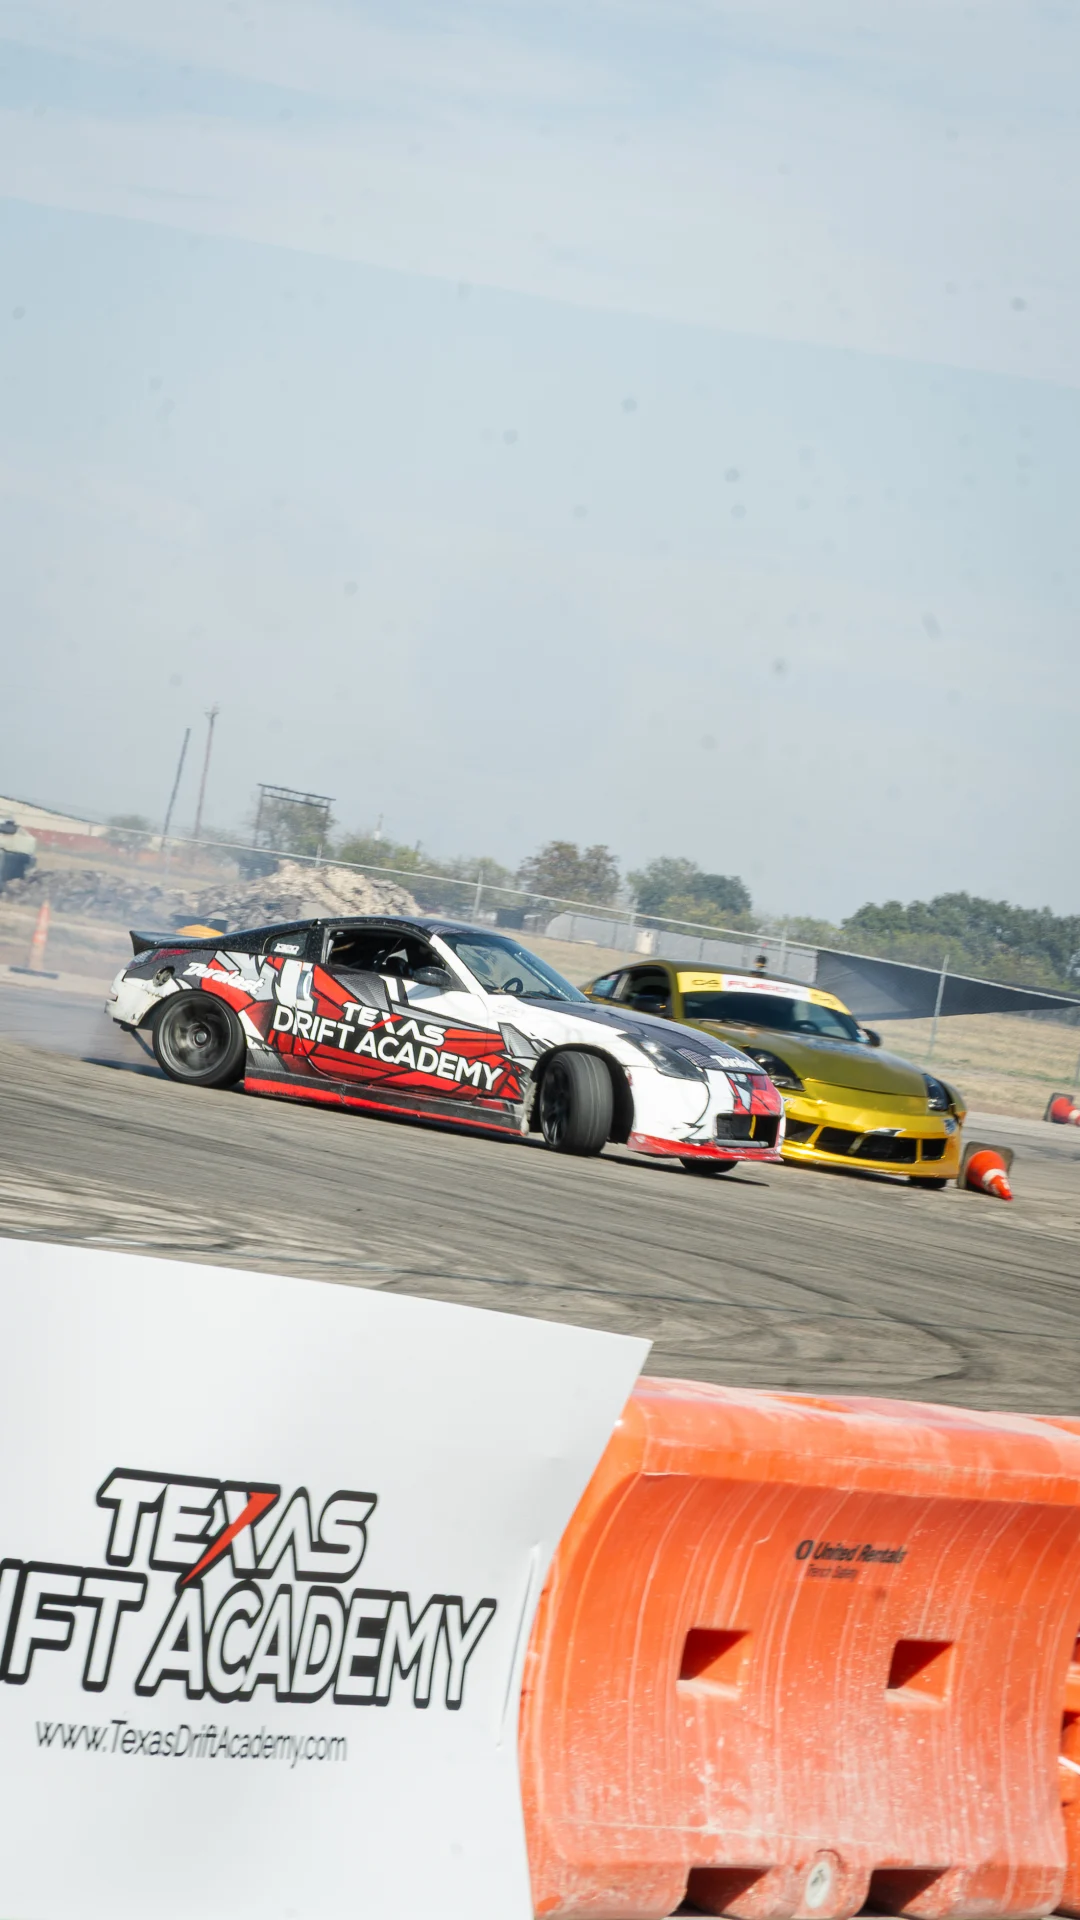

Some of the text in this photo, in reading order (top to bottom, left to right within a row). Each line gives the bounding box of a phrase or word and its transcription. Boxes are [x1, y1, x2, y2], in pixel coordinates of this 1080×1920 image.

[183, 962, 265, 995] Duralast
[272, 1004, 504, 1091] DRIFT ACADEMY
[342, 1001, 447, 1047] TEXAS
[96, 1467, 378, 1585] TEXAS
[814, 1541, 907, 1563] United Rentals
[136, 1579, 498, 1710] ACADEMY
[36, 1718, 348, 1769] www.TexasDriftAcademy.com
